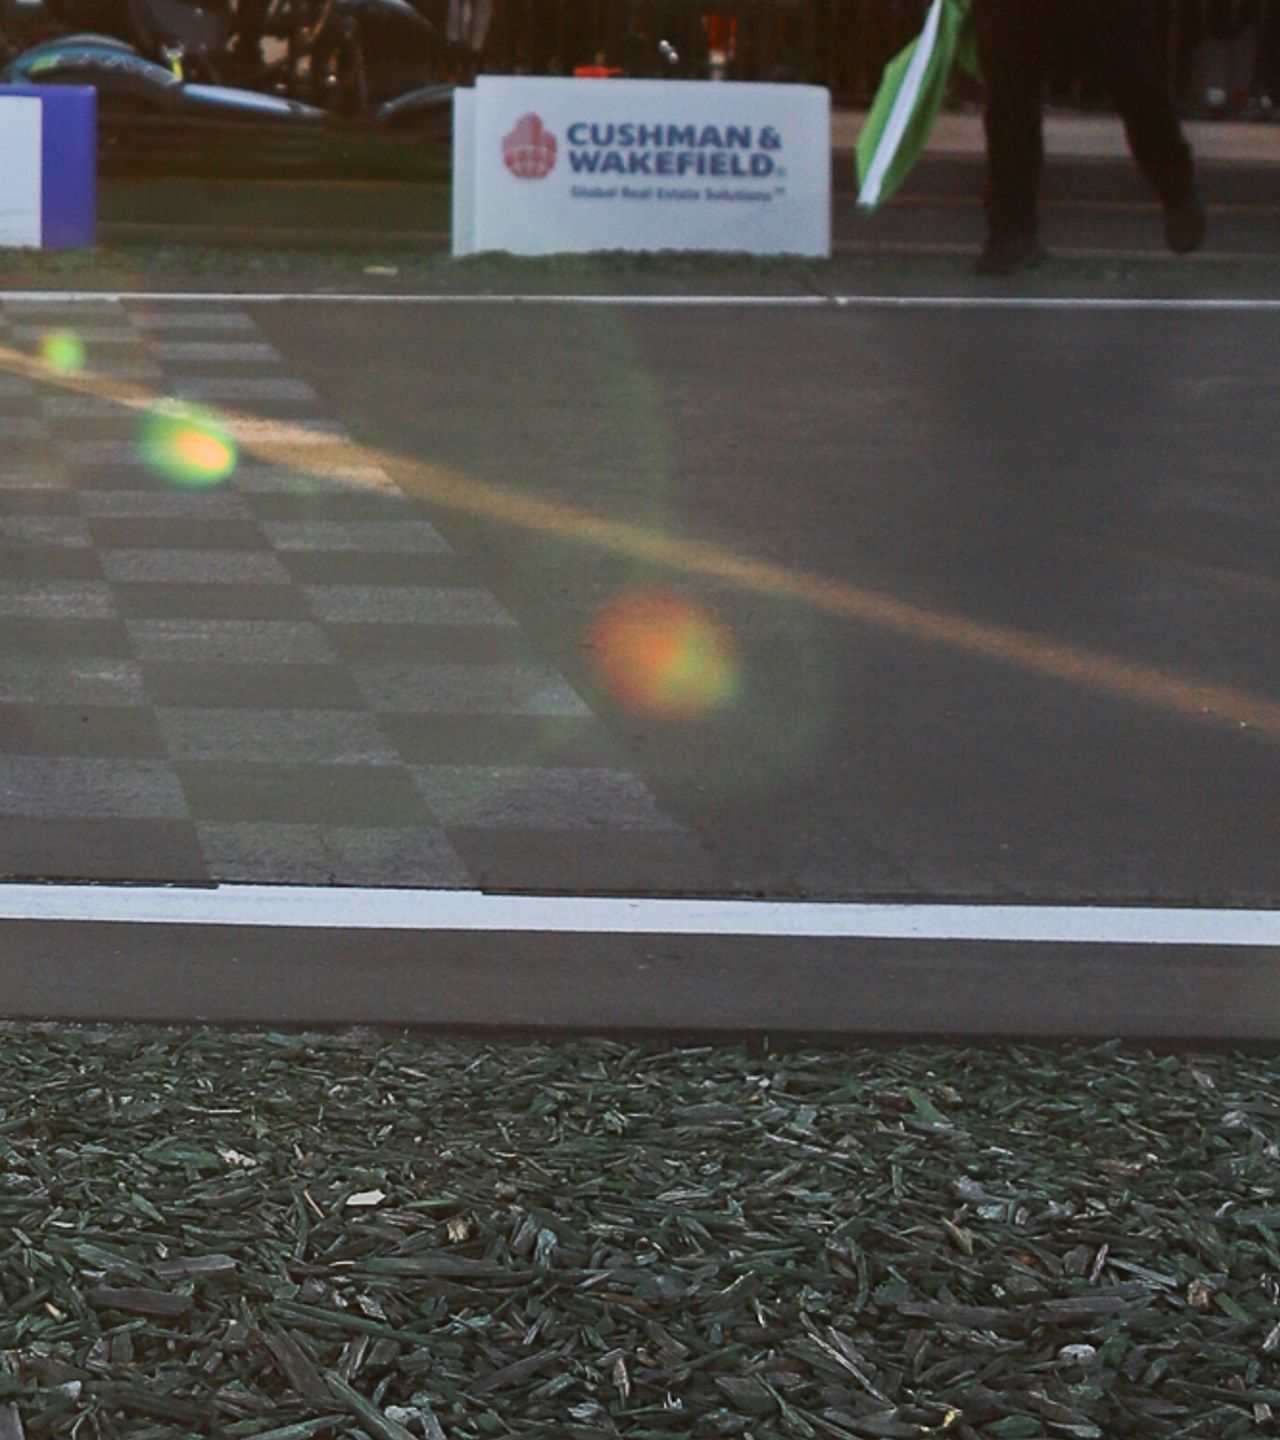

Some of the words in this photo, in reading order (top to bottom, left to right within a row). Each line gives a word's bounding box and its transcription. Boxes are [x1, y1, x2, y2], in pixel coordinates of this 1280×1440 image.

[566, 122, 752, 149] CUSHMAN
[758, 125, 783, 150] &
[570, 184, 618, 199] Global
[621, 185, 653, 200] Real
[656, 186, 701, 201] Estate
